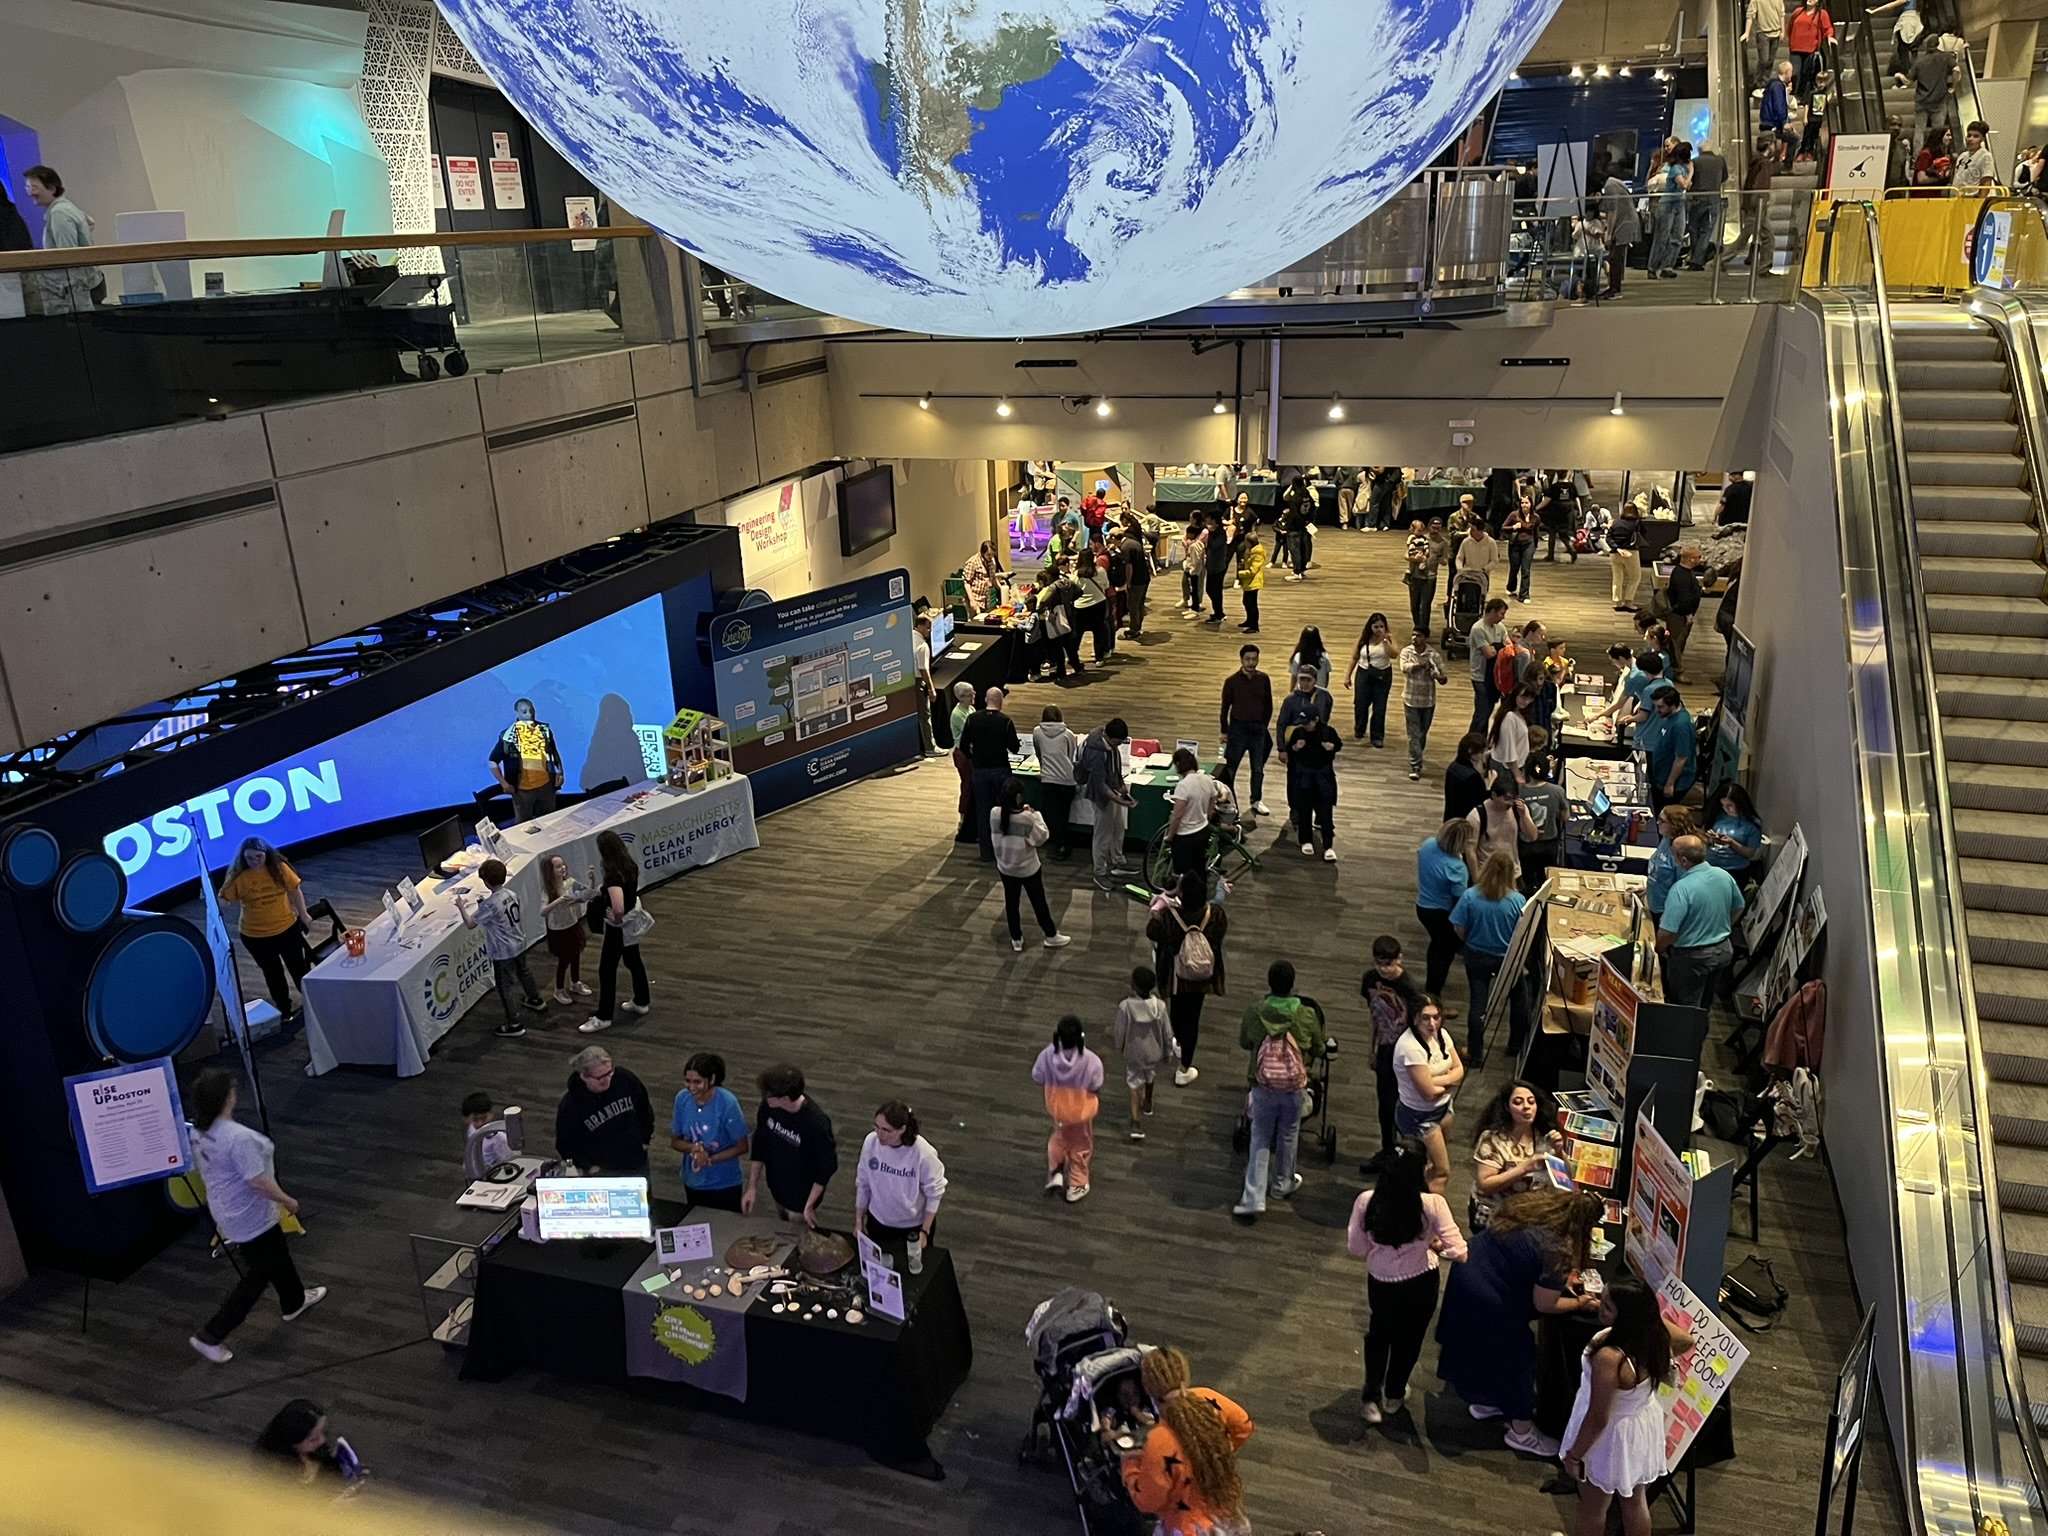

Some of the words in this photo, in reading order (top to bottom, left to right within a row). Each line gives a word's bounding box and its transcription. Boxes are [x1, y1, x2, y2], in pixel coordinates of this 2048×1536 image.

[458, 188, 476, 196] ENTER
[1981, 238, 1989, 275] 1
[737, 512, 775, 534] Engineering
[750, 526, 772, 541] Design
[756, 532, 787, 552] Workshop
[790, 608, 801, 616] can
[802, 604, 815, 613] take
[641, 799, 741, 844] MASSACHUSETTS
[642, 835, 685, 857] CLEAN
[689, 814, 736, 842] ENERGY
[644, 846, 692, 870] CENTER
[504, 902, 521, 927] 10
[456, 944, 487, 978] CLEAN
[92, 1084, 117, 1097] RISE
[94, 1094, 112, 1105] UP
[112, 1088, 151, 1102] BOSTON
[583, 1096, 634, 1132] BRANDEIS
[1665, 1279, 1692, 1308] HOW
[1693, 1309, 1710, 1329] DO
[1711, 1327, 1739, 1359] YOU
[671, 1324, 701, 1339] Nature
[1690, 1328, 1717, 1359] KEEP
[1690, 1353, 1725, 1392] COOL?
